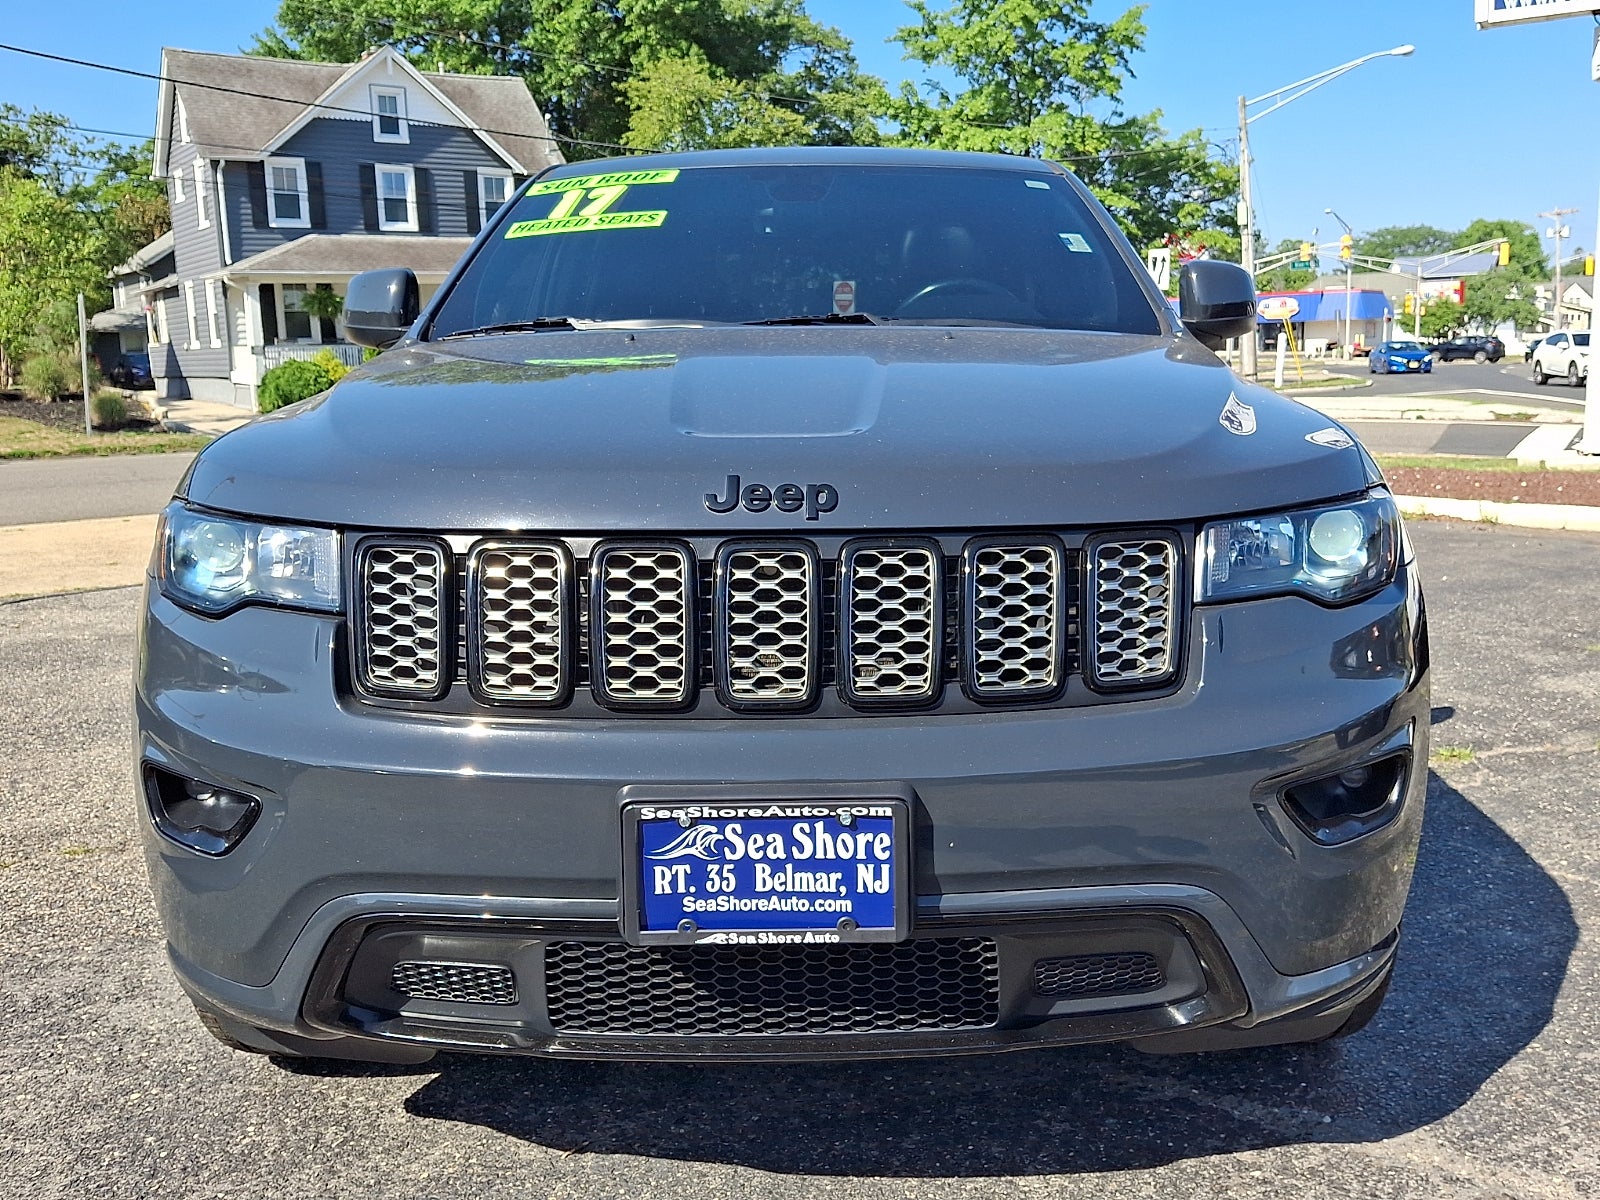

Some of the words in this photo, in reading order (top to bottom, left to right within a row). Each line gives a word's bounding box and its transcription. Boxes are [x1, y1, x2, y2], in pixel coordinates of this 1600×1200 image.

[537, 177, 592, 193] SUN
[597, 172, 668, 185] ROOF
[547, 185, 628, 219] 17
[511, 217, 590, 234] HEATED
[593, 213, 660, 226] SEATS
[703, 474, 839, 521] Jeep
[640, 806, 893, 820] SeaShoreAuto.com
[724, 823, 786, 861] Sea
[791, 821, 891, 861] Shore
[653, 865, 696, 895] RT.
[706, 864, 736, 893] 35
[754, 863, 847, 897] Belmar,
[856, 864, 890, 894] NJ
[682, 896, 853, 913] SeaShoreAuto.com
[728, 932, 757, 945] Sea
[757, 932, 803, 945] Shore
[804, 932, 840, 944] Auto
